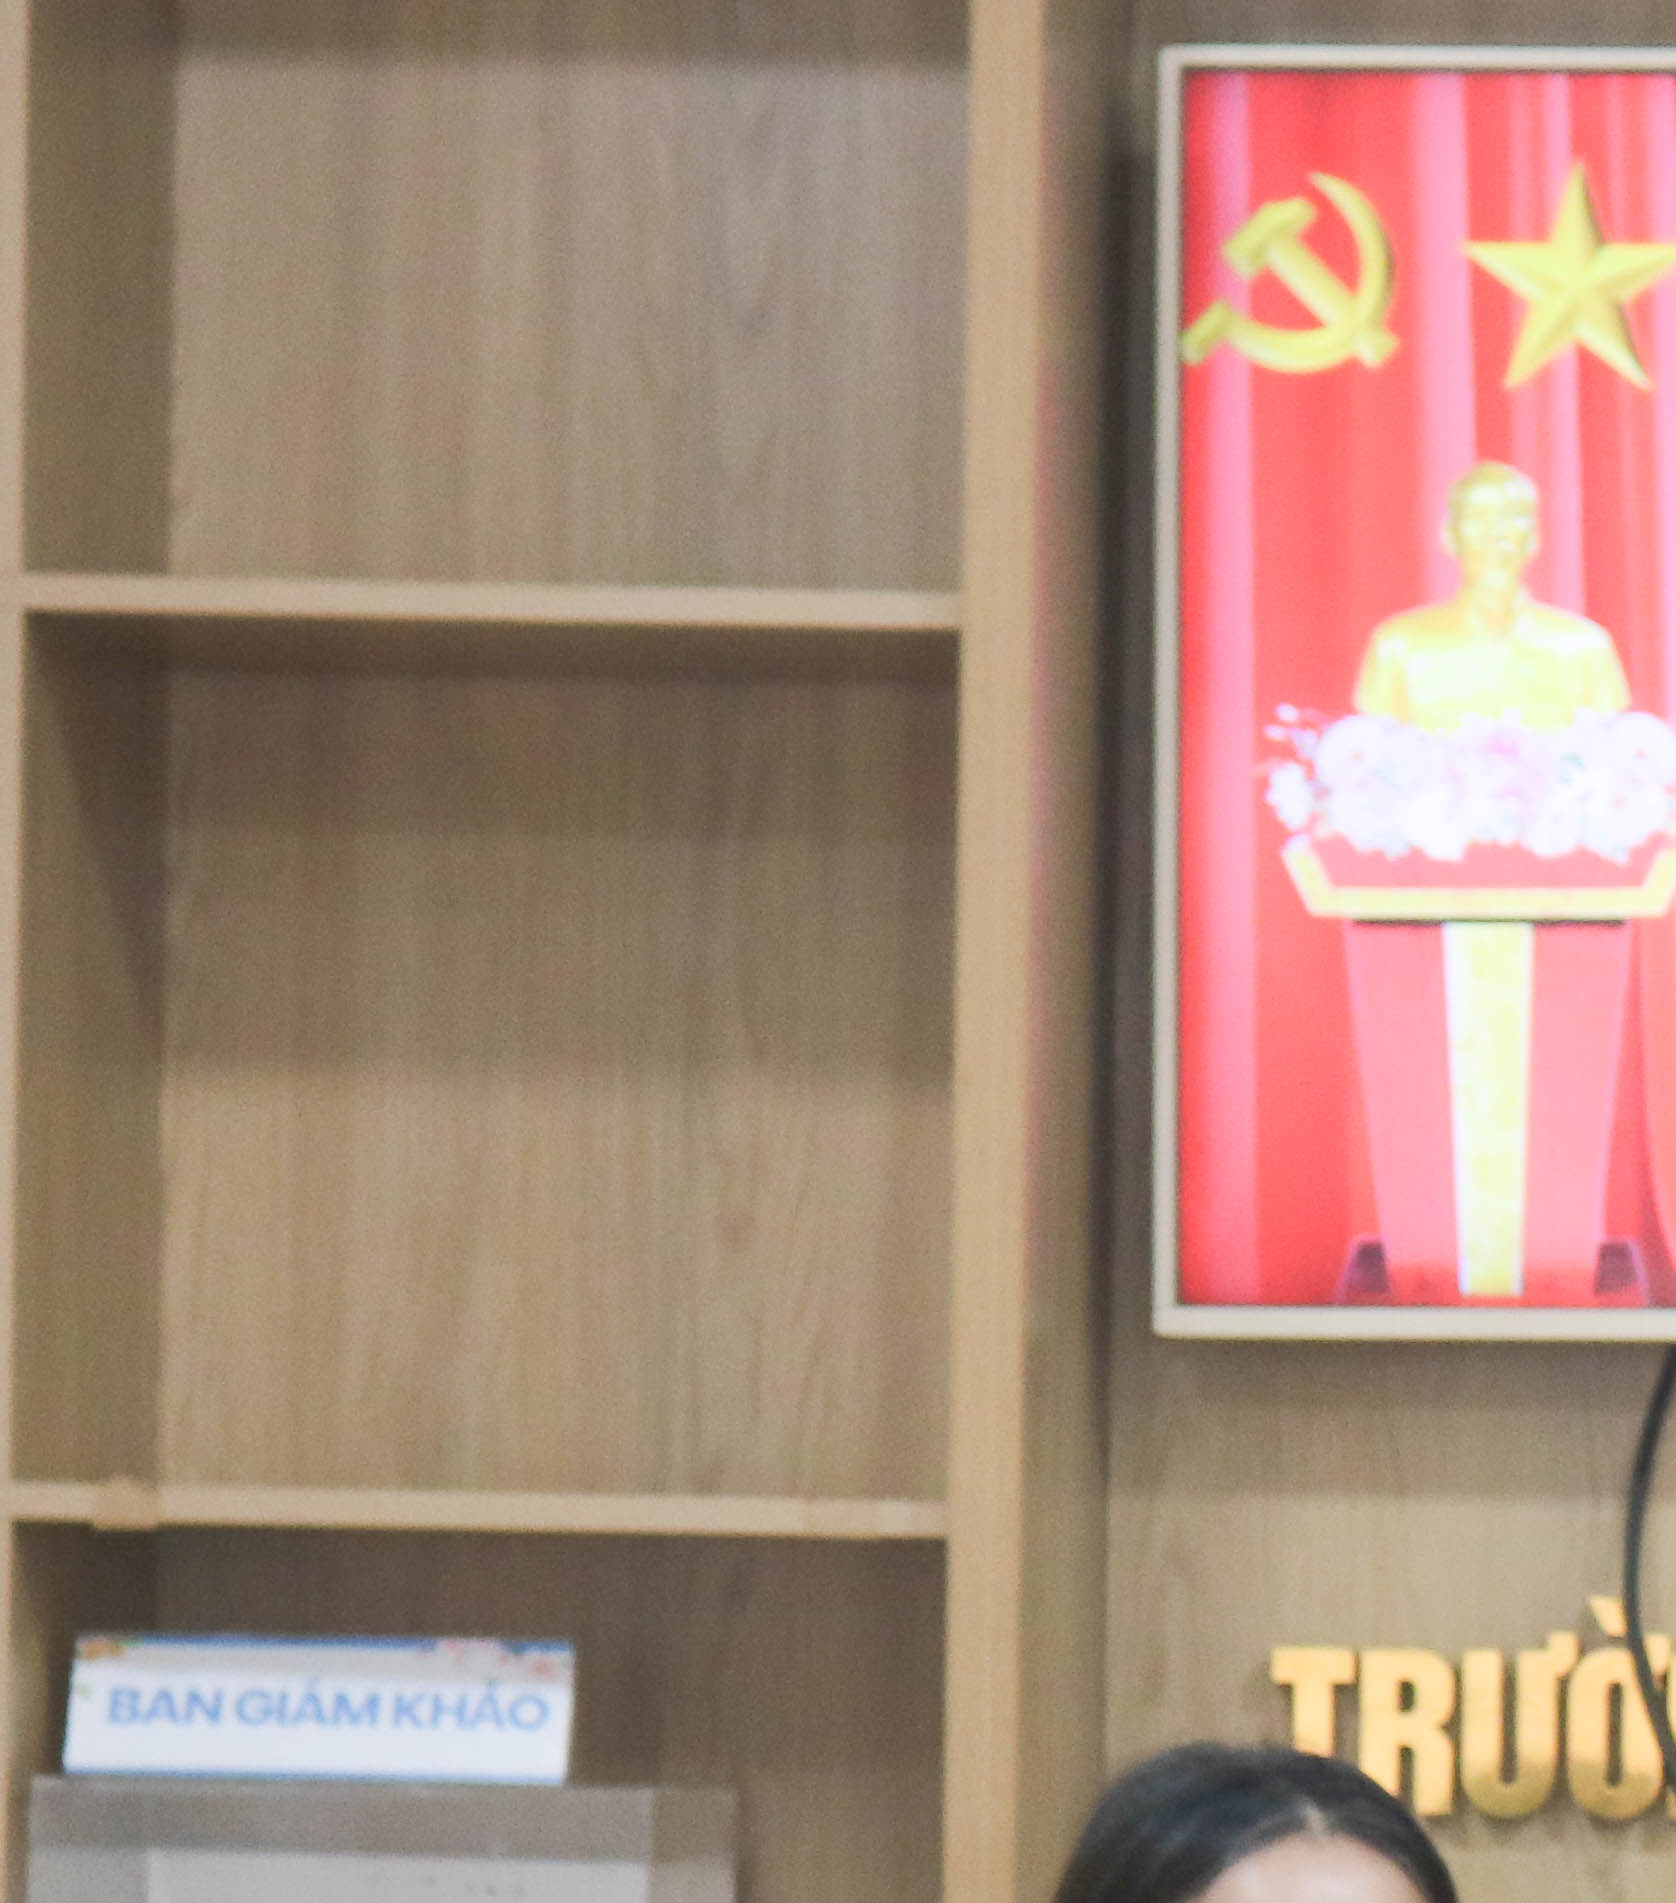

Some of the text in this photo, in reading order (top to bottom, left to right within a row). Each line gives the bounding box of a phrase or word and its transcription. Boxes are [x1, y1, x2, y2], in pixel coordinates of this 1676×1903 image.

[107, 1679, 551, 1733] BAN GIÁM KHẢO
